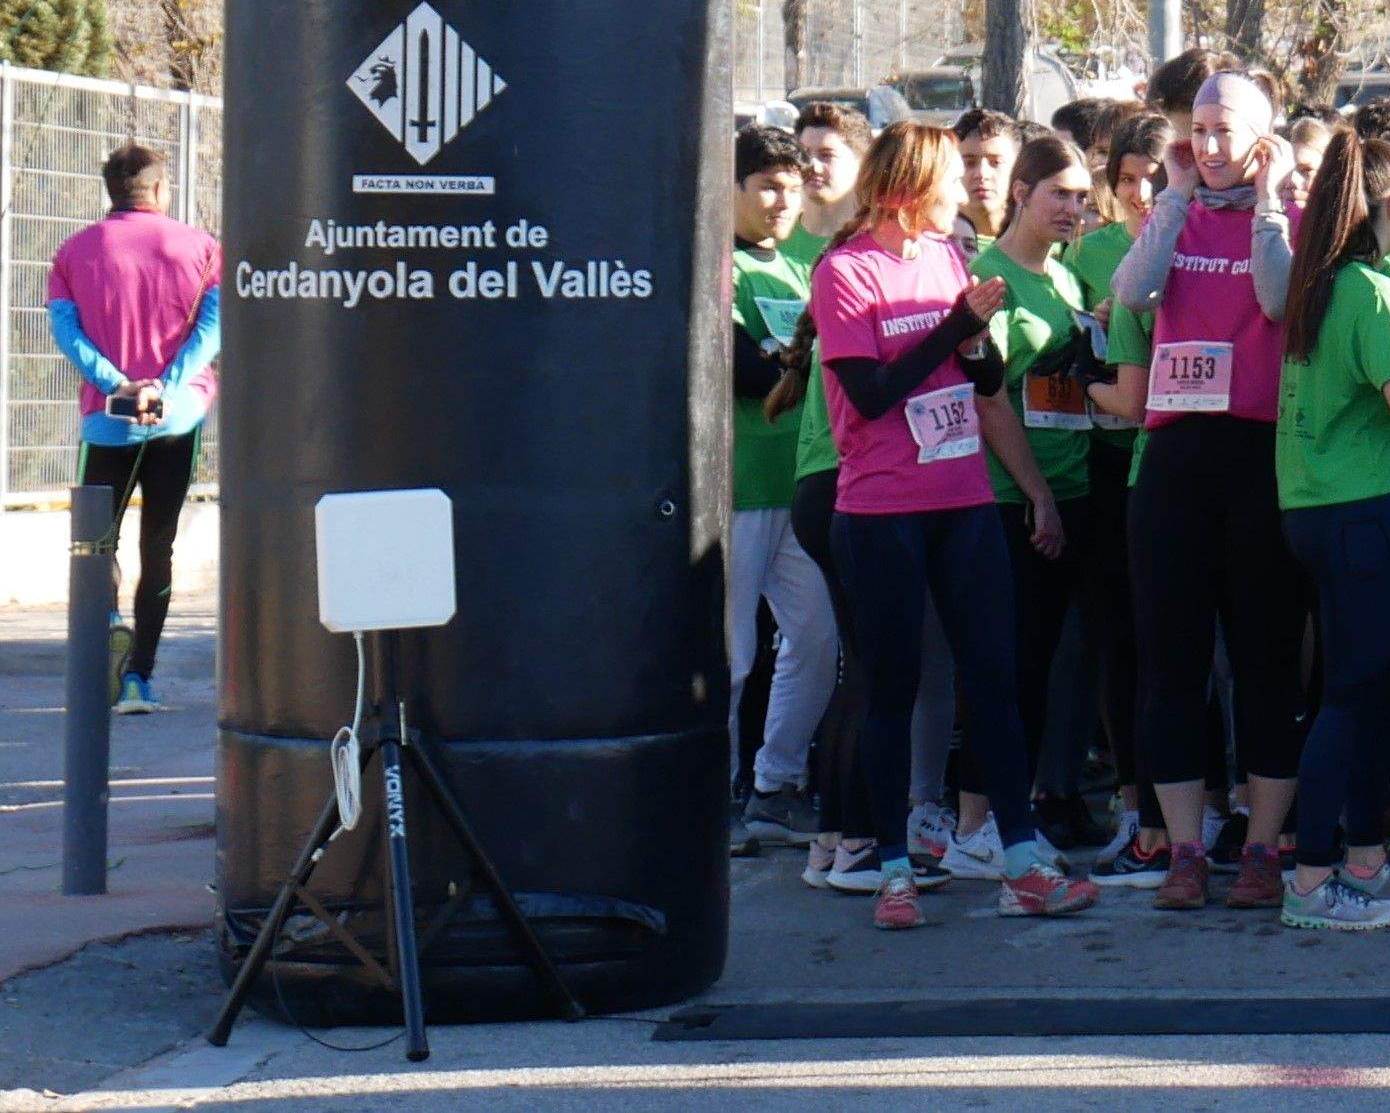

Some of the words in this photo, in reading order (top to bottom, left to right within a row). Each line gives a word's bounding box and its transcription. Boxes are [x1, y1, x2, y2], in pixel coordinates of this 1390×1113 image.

[361, 179, 401, 190] FACTA
[405, 180, 434, 190] NON
[439, 180, 485, 190] VERBA
[304, 218, 496, 255] Ajuntament
[505, 219, 548, 248] de
[236, 260, 434, 308] Cerdanyola
[448, 261, 518, 298] del
[531, 259, 653, 298] Vallès
[1169, 356, 1216, 379] 1153
[929, 401, 968, 431] 1152
[384, 765, 406, 837] VONYX
